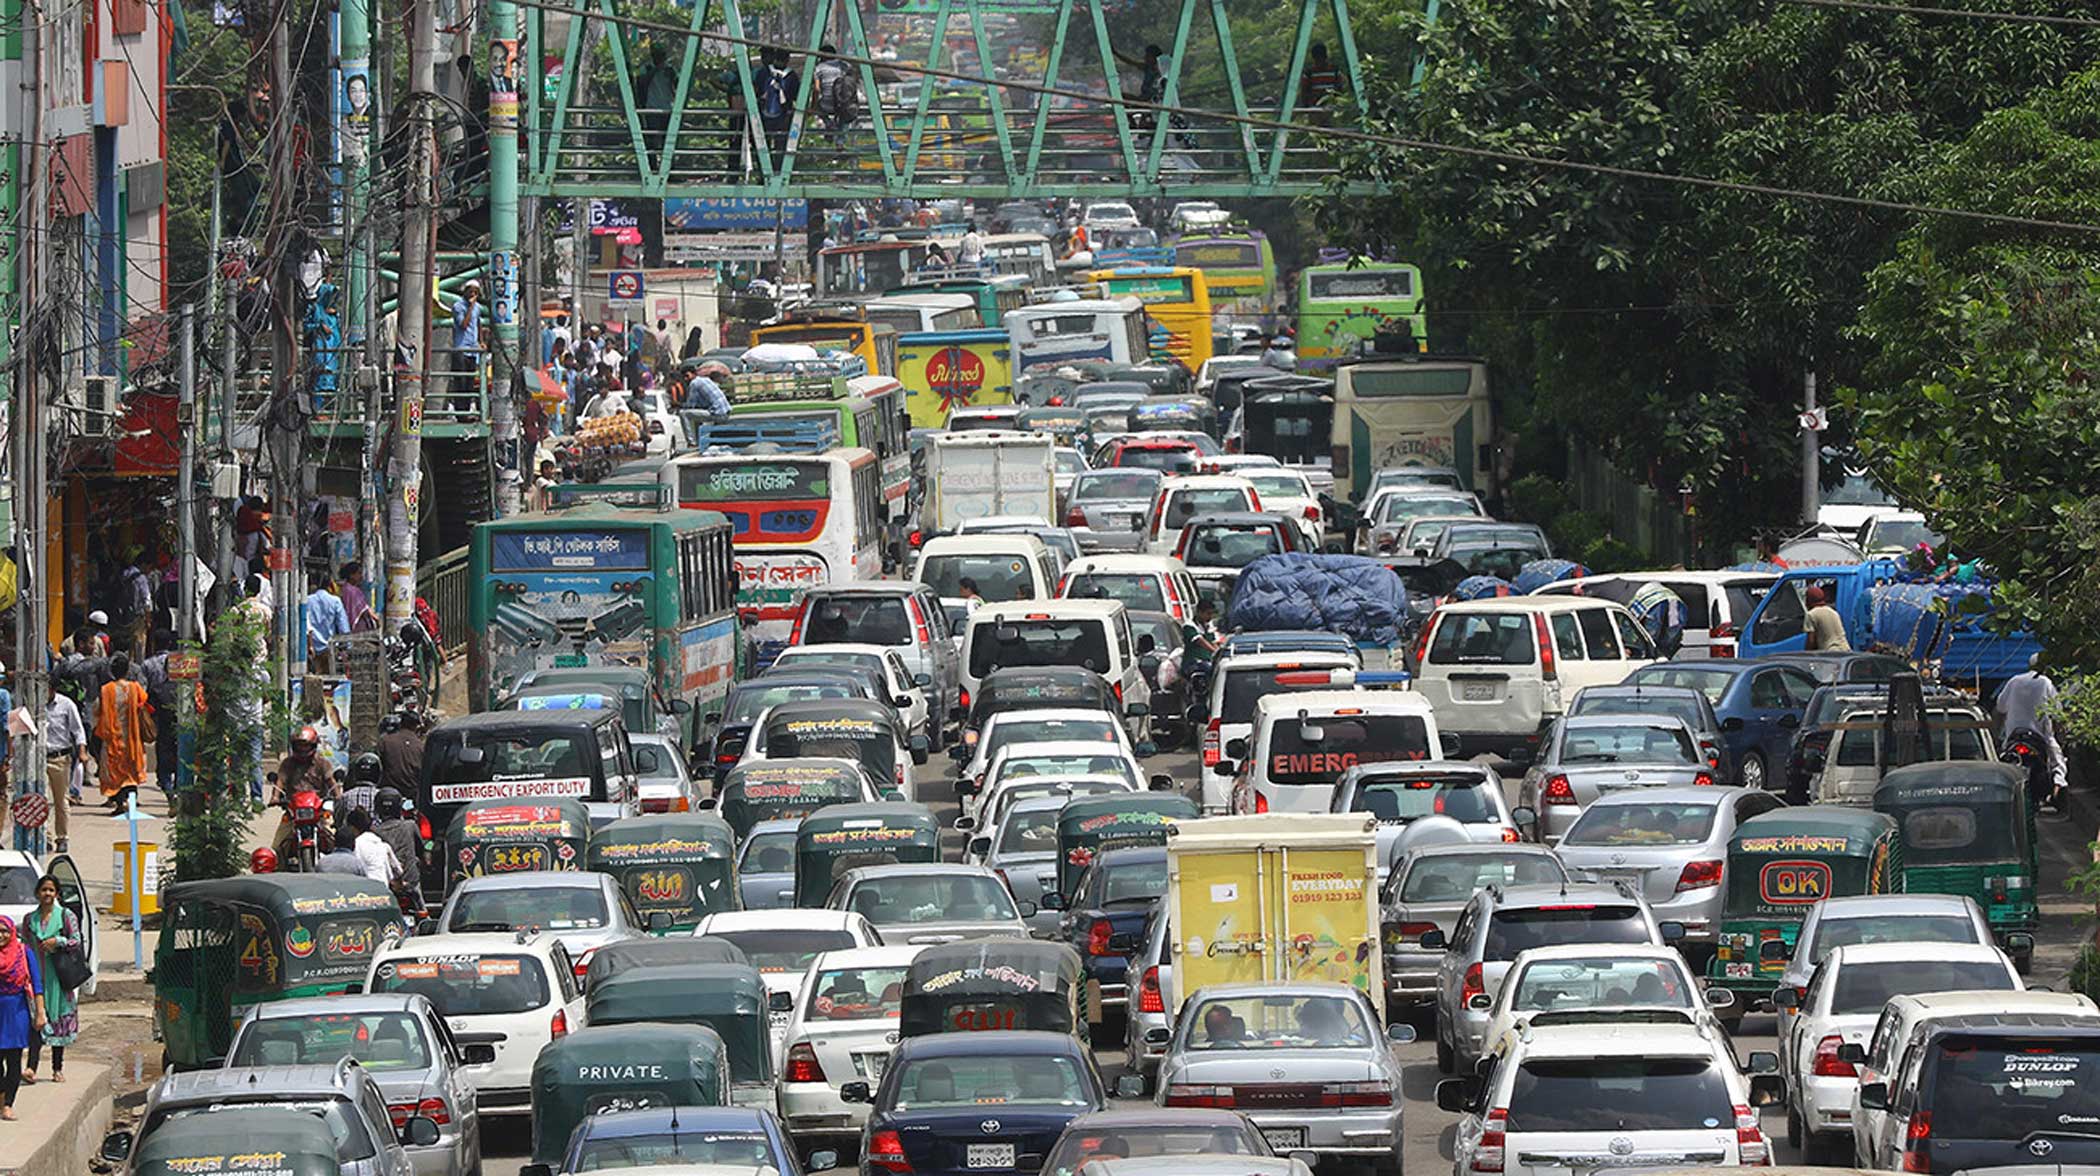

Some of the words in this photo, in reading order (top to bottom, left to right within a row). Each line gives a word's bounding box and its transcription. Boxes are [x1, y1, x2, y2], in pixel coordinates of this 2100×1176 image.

[435, 788, 450, 800] ON
[452, 784, 514, 799] EMERGENCY
[516, 782, 555, 797] EXPORT
[558, 781, 585, 793] DUTY
[1292, 880, 1363, 891] EVERYDAY
[1778, 871, 1819, 894] OK
[579, 1066, 668, 1080] PRIVATE.
[2003, 1063, 2077, 1072] DUNLOP
